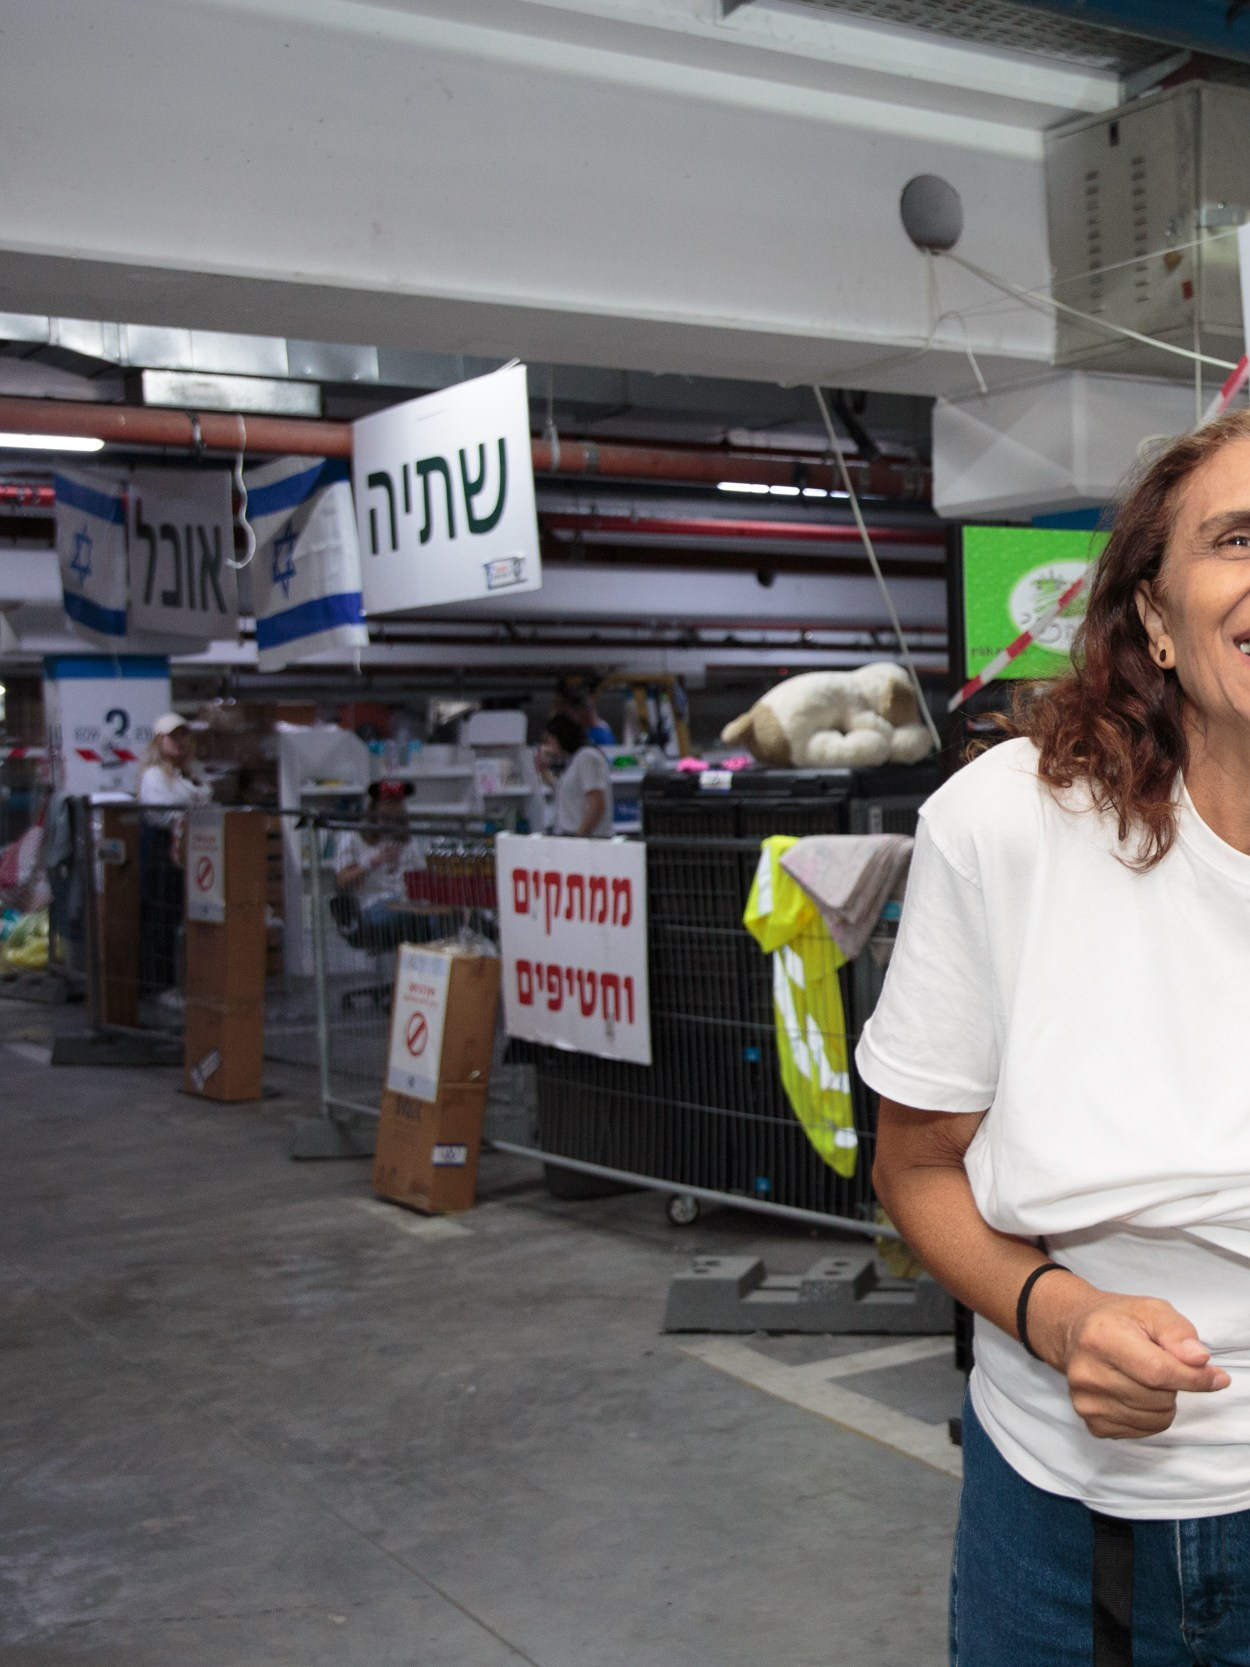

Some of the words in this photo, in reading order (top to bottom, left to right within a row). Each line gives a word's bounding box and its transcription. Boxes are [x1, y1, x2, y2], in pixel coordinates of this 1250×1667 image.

[367, 437, 507, 556] שתיה
[135, 498, 227, 613] אוכל
[512, 867, 632, 936] ממתקים
[516, 959, 635, 1025] וחטיפים
